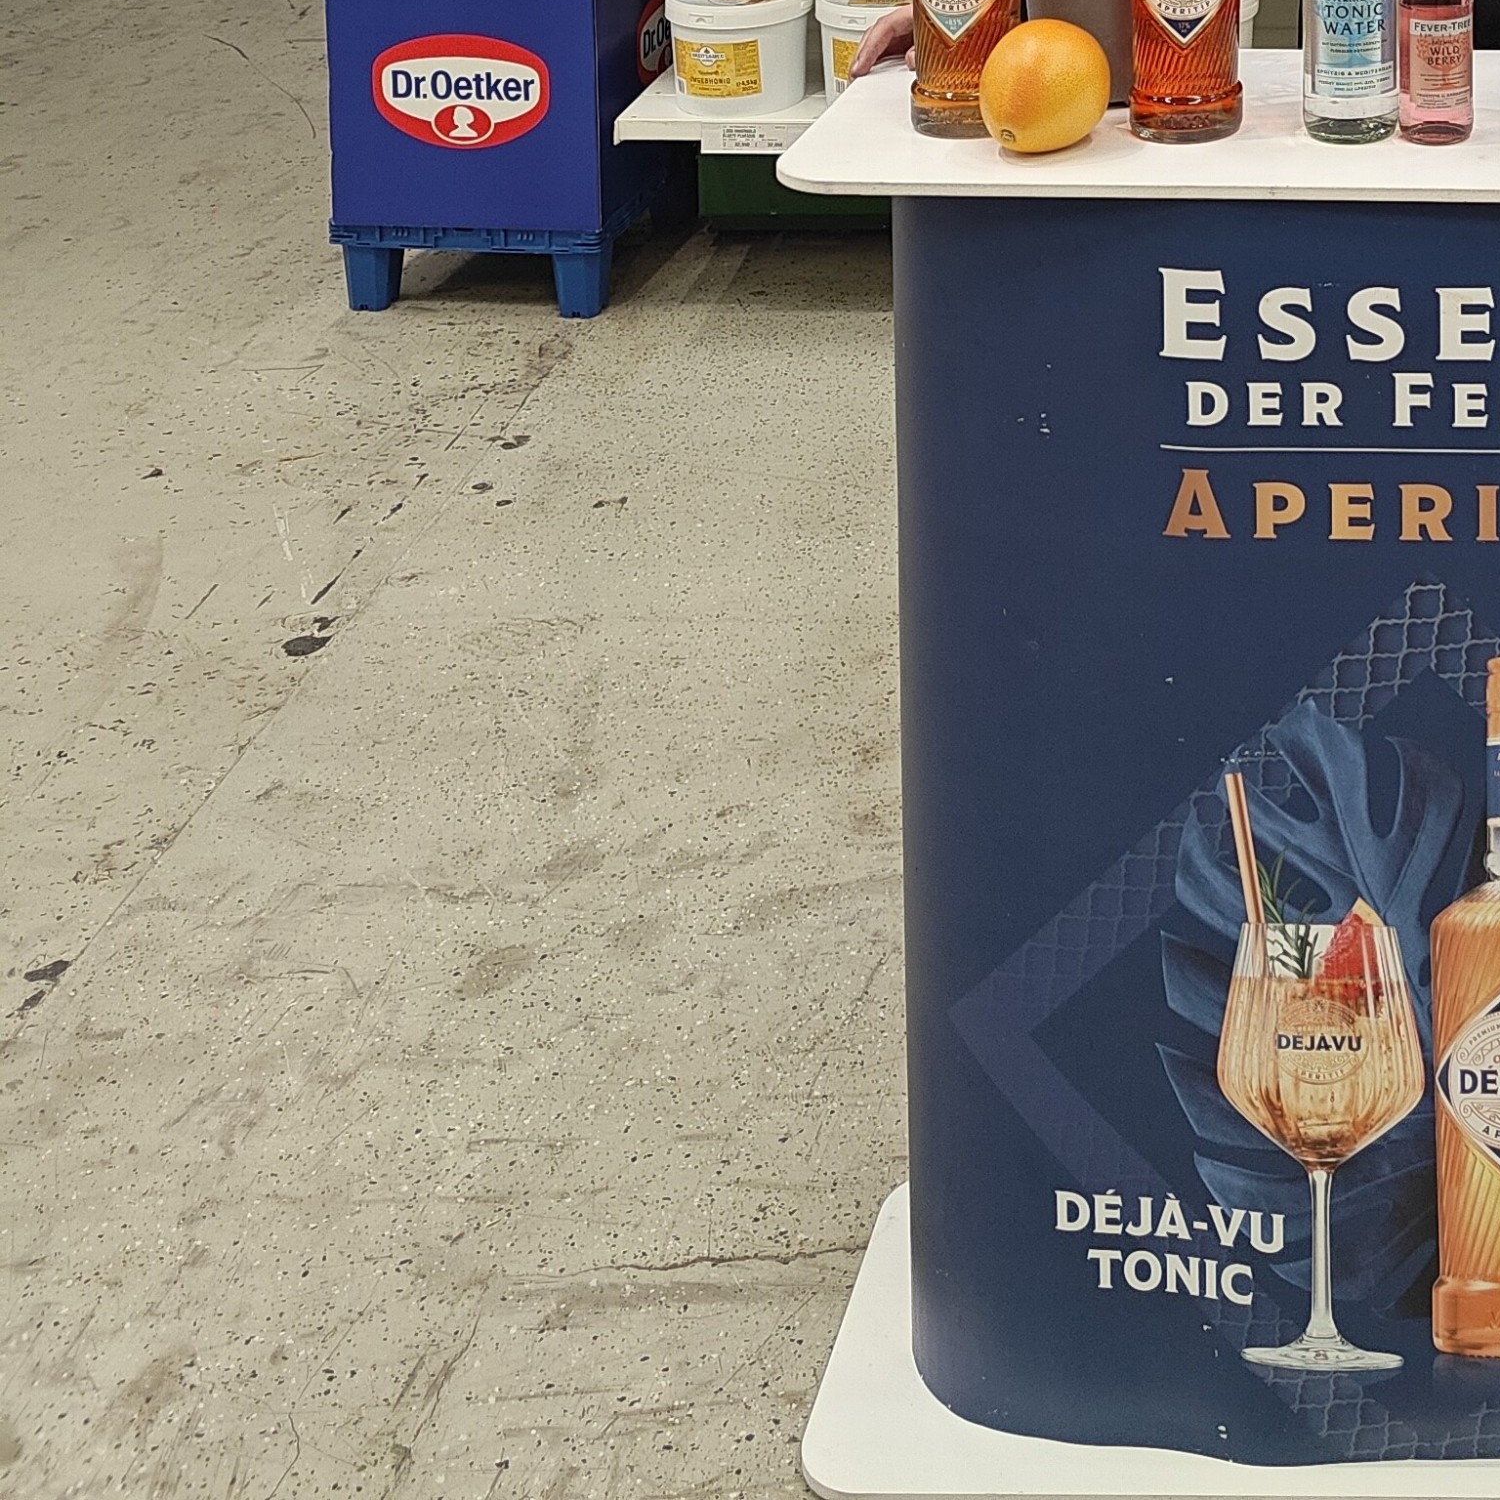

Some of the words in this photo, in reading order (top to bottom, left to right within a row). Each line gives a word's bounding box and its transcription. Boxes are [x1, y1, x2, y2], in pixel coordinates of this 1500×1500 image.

[1157, 0, 1211, 15] APERITIF
[1325, 2, 1384, 19] TONIC
[1324, 19, 1386, 36] WATER
[1414, 18, 1472, 33] FEVER-TREE
[643, 17, 671, 59] Dr.Oe
[1430, 45, 1460, 56] WILD
[1427, 54, 1463, 66] BERRY
[1185, 381, 1345, 427] DER
[1054, 1188, 1286, 1254] DÉJÀ-VU
[1087, 1248, 1254, 1305] TONIC
